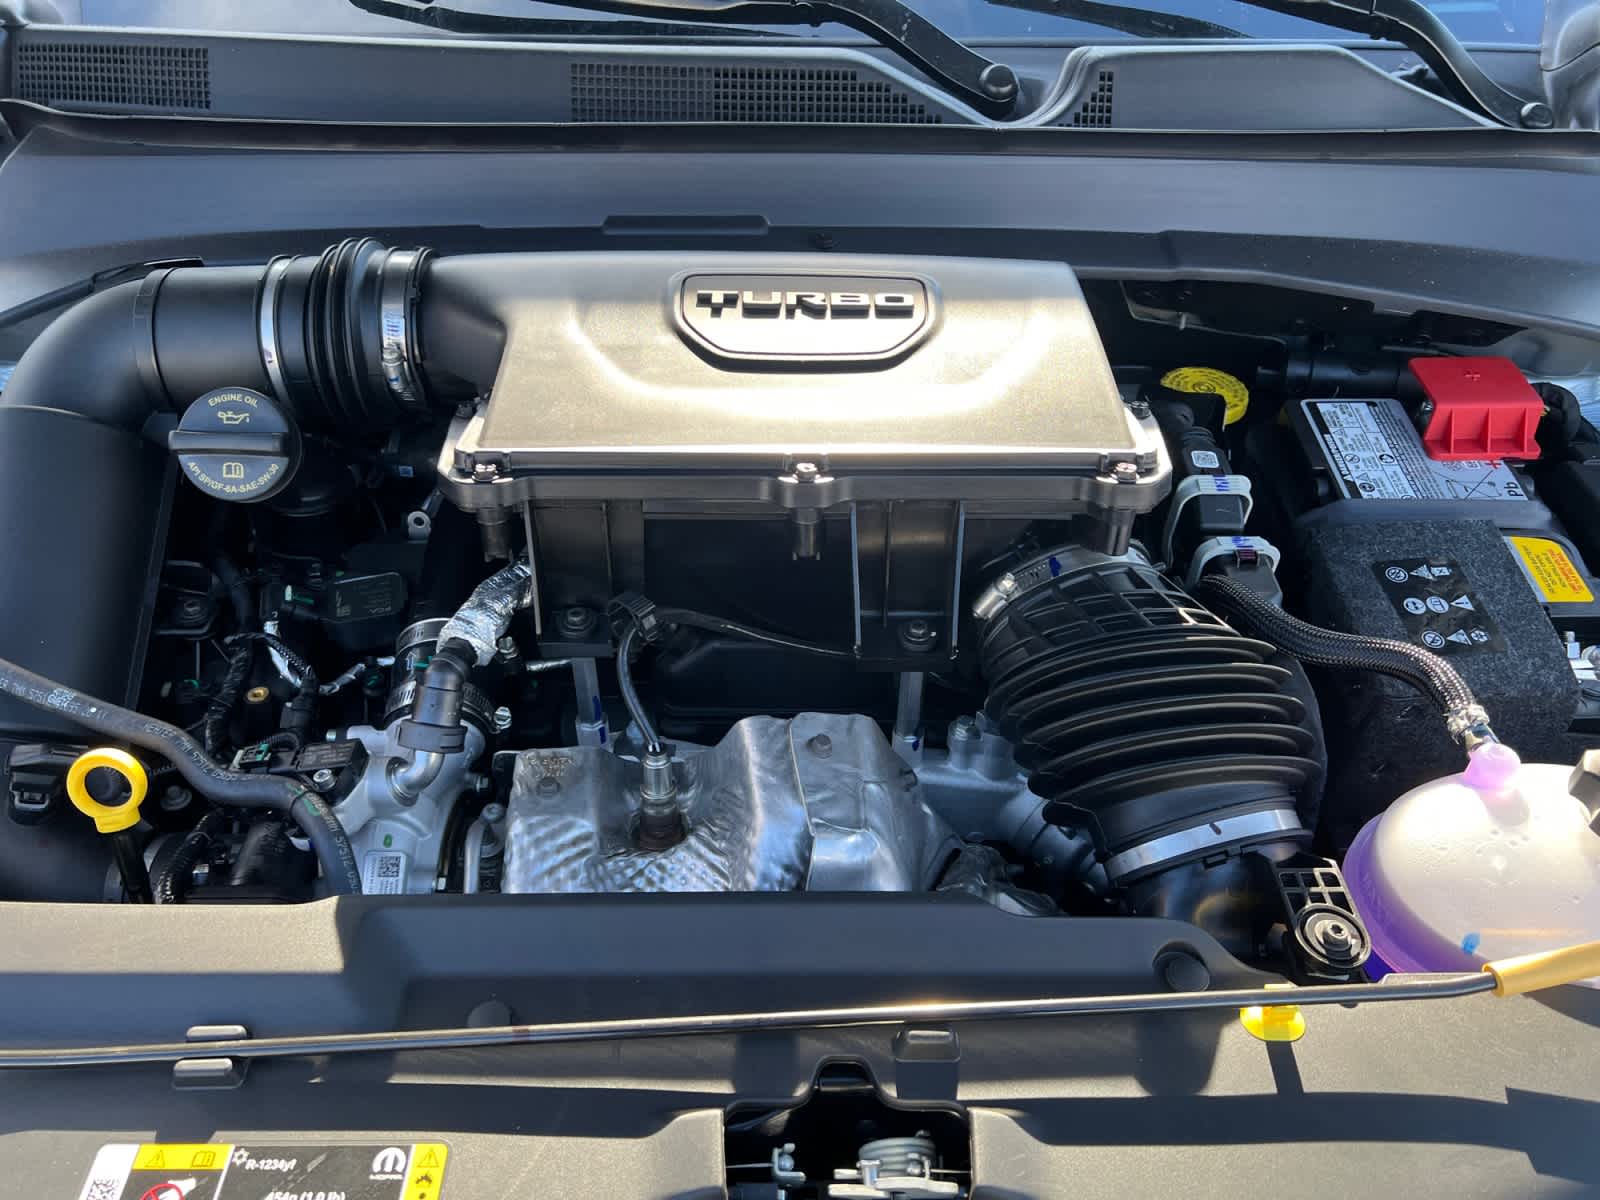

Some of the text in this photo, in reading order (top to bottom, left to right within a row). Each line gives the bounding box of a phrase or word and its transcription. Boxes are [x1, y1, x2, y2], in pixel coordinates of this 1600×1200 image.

[695, 288, 915, 319] TURBO
[208, 393, 258, 408] ENGINE OIL
[188, 462, 201, 476] API
[1503, 481, 1523, 497] Pb
[244, 1159, 297, 1172] R-1234yf
